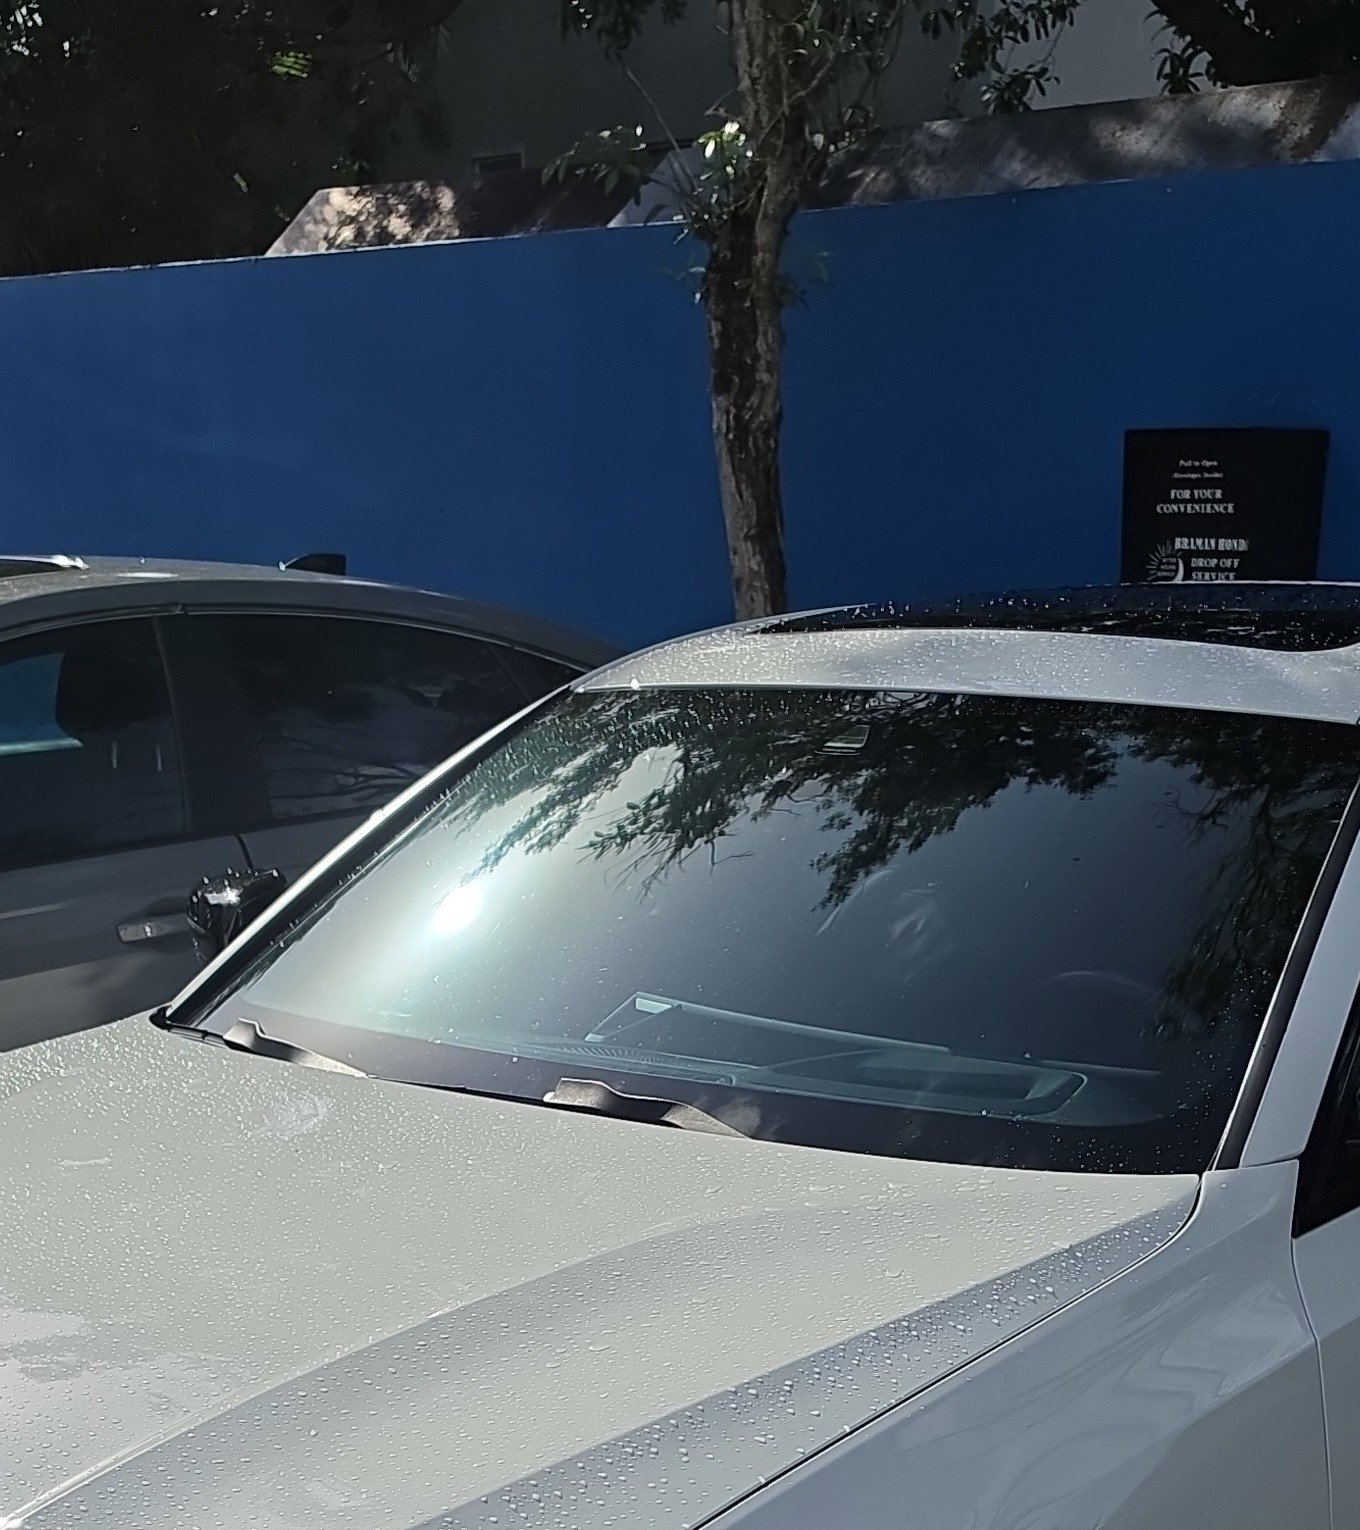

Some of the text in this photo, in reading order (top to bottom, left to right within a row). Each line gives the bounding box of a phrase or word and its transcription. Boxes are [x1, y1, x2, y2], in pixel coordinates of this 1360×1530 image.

[1170, 489, 1222, 499] FOR YOUR
[1156, 503, 1235, 514] CONVENIENCE
[1174, 537, 1216, 550] BRAMAN
[1191, 557, 1240, 569] DROP OFF
[1191, 571, 1236, 581] SERVICE
